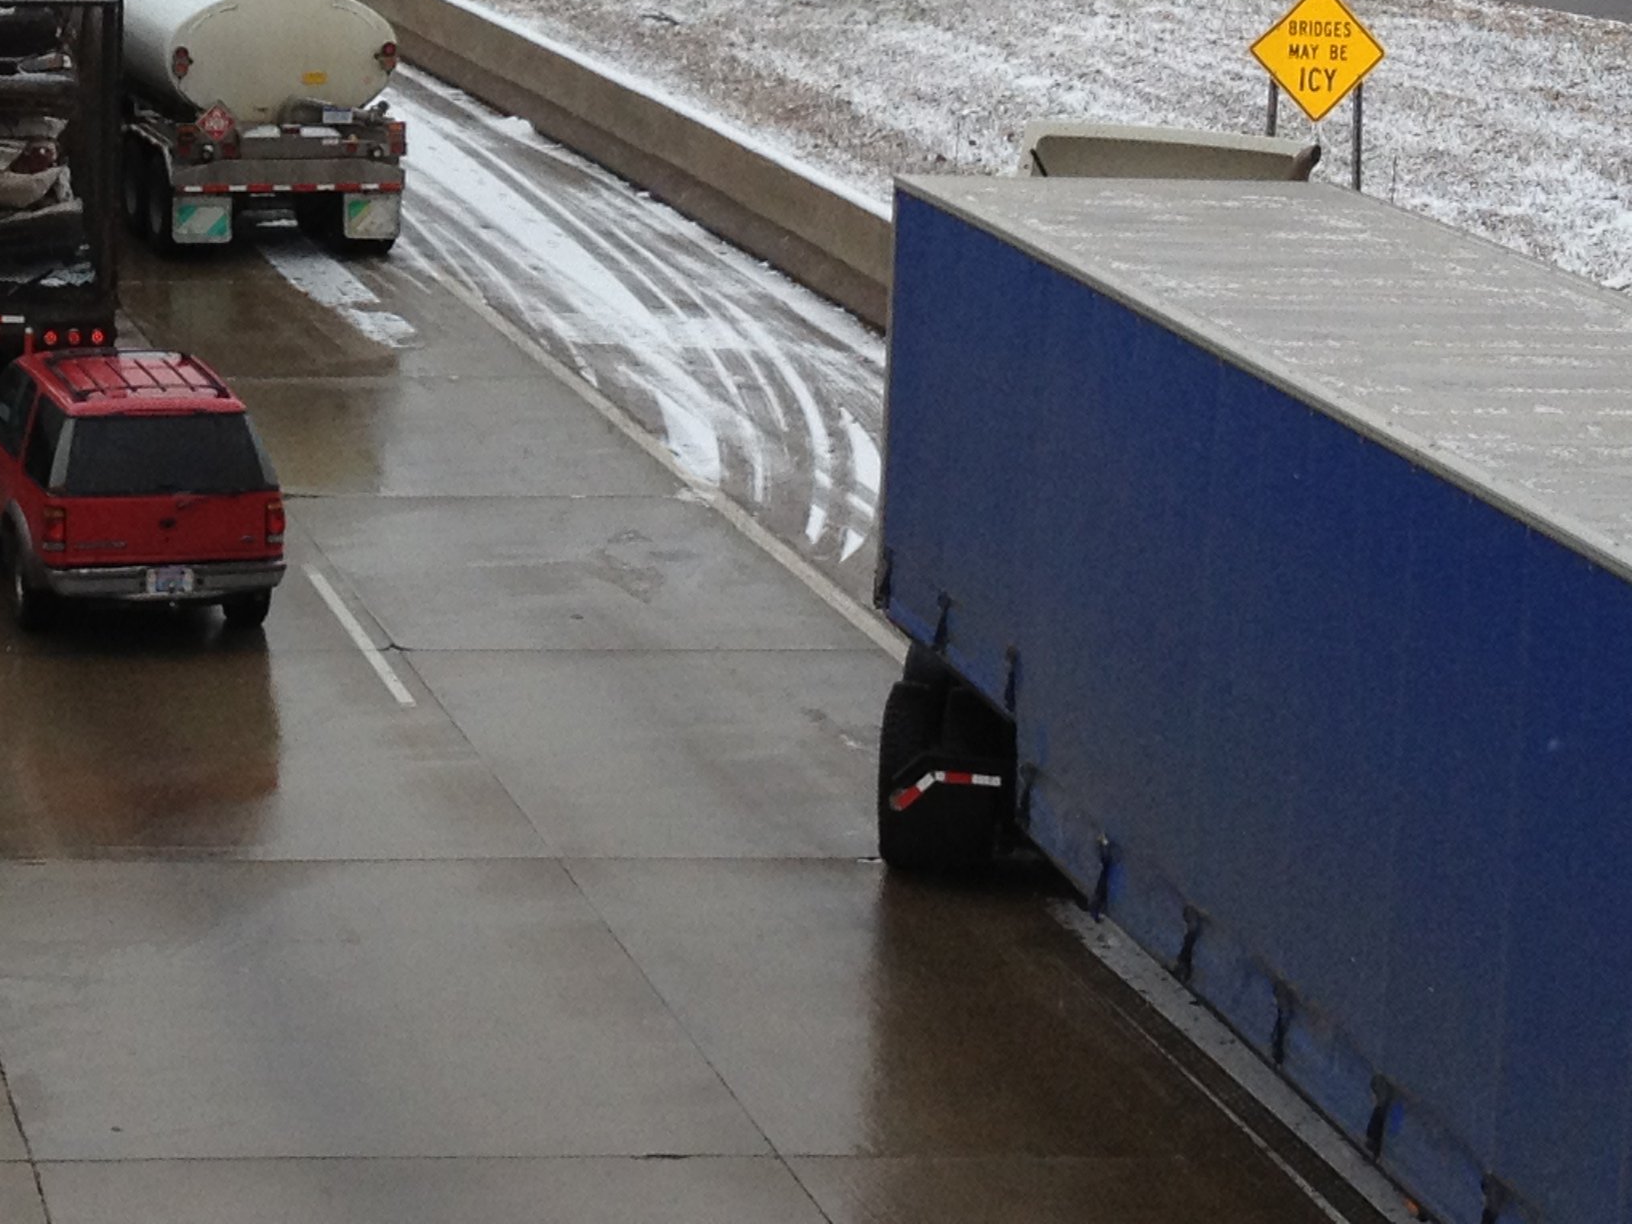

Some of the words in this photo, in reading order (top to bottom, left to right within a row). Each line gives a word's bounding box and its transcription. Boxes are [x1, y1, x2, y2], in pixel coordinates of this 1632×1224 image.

[1288, 20, 1352, 38] BRIDGES
[1288, 43, 1319, 59] MAY
[1329, 44, 1348, 61] BE
[1299, 67, 1337, 92] ICY
